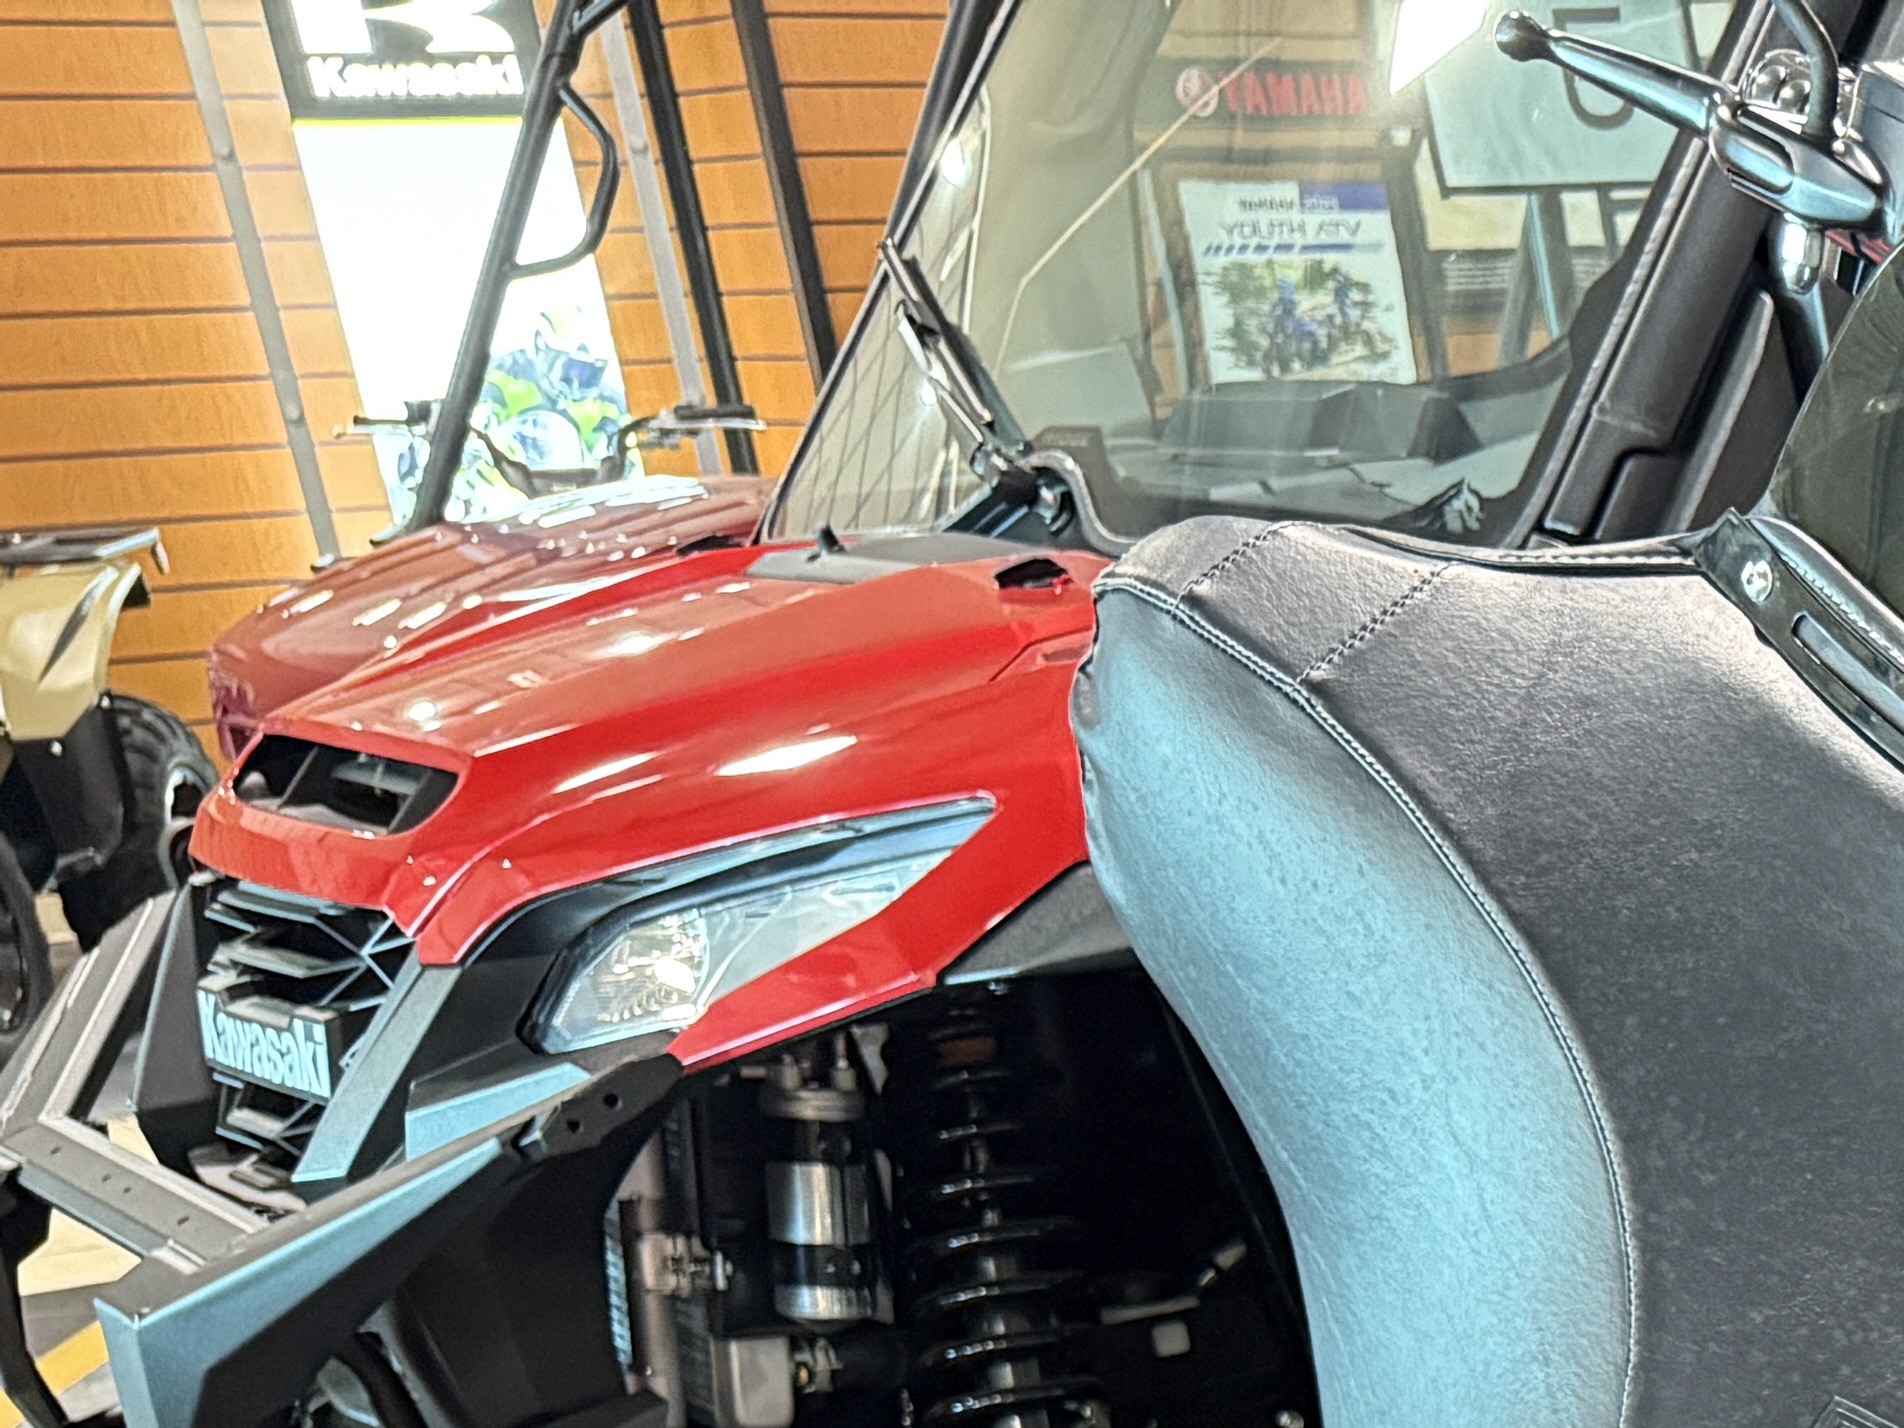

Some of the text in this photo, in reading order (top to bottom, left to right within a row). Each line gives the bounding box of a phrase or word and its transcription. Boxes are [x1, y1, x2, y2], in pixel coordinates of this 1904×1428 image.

[306, 54, 524, 97] Kawasaki
[1218, 70, 1370, 116] YAMAHA
[1218, 218, 1307, 241] YOUTH
[197, 988, 331, 1099] Kawasaki
